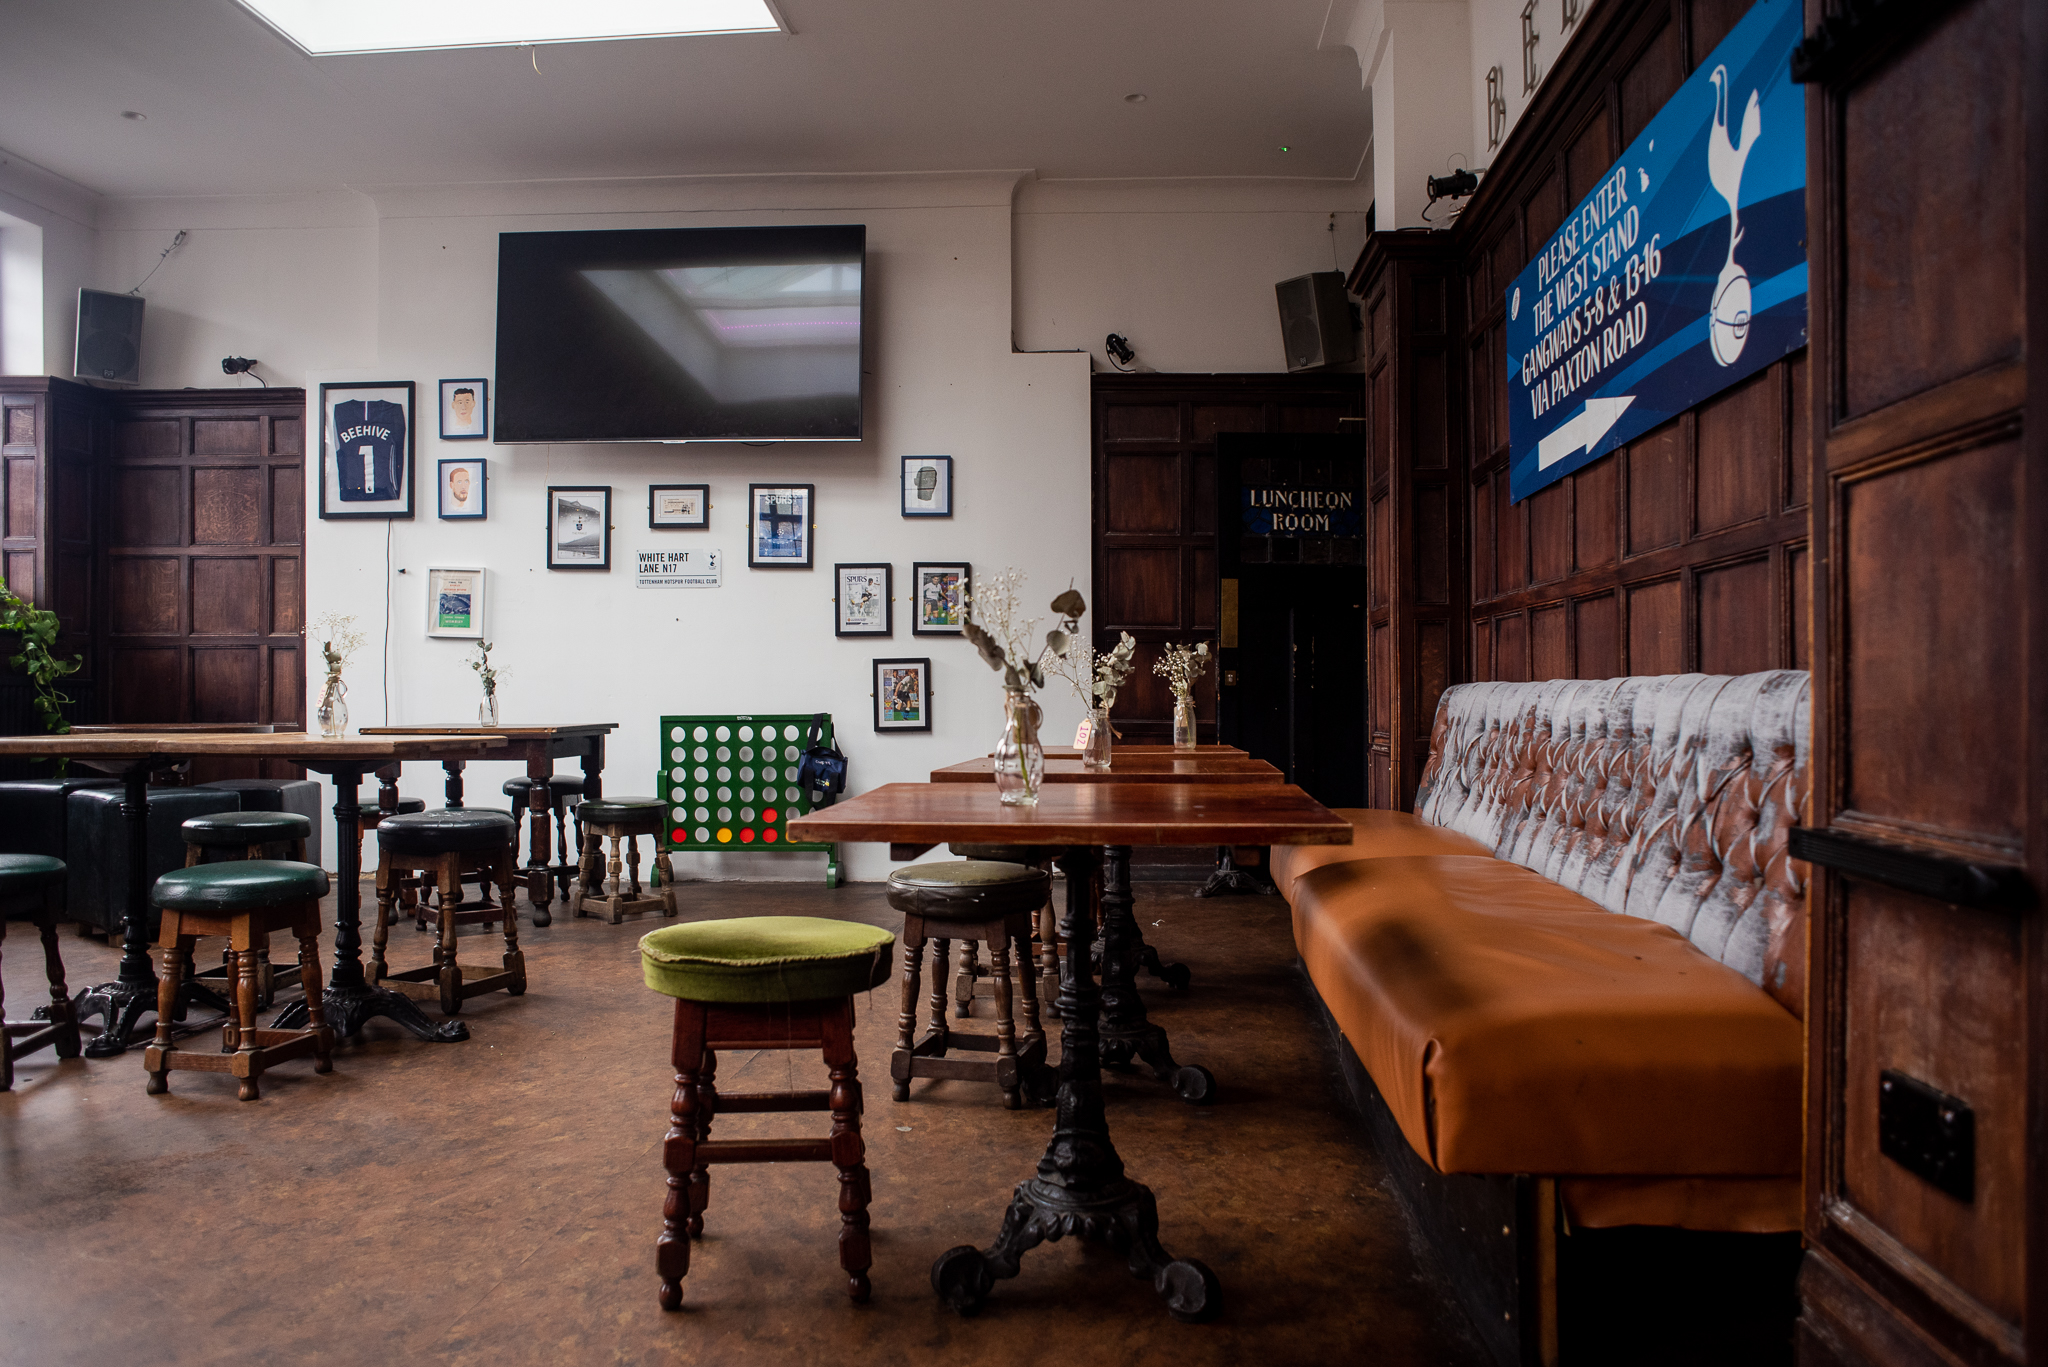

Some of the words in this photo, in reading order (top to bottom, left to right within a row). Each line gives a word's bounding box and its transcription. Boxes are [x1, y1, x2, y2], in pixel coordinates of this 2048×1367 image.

[1538, 217, 1580, 292] PLEASE
[1582, 166, 1628, 245] ENTER
[1533, 289, 1554, 337] THE
[1555, 252, 1590, 314] WEST
[1592, 205, 1639, 281] STAND
[1522, 306, 1582, 386] GANGWAYS
[1583, 286, 1604, 335] 5-8
[1607, 275, 1621, 316] &
[1624, 233, 1662, 301] 13-16
[1531, 379, 1550, 419] VIA
[1551, 336, 1601, 406] PAXTON
[1603, 301, 1647, 368] ROAD
[340, 425, 391, 443] BEEHIVE
[358, 445, 375, 493] 1
[765, 495, 792, 504] SPURS
[1250, 489, 1352, 508] LUNCHEON
[1273, 513, 1329, 531] ROOM
[639, 552, 665, 562] WHITE
[668, 552, 689, 562] HART
[639, 563, 659, 573] LANE
[662, 563, 677, 573] N17
[1076, 726, 1089, 745] 102
